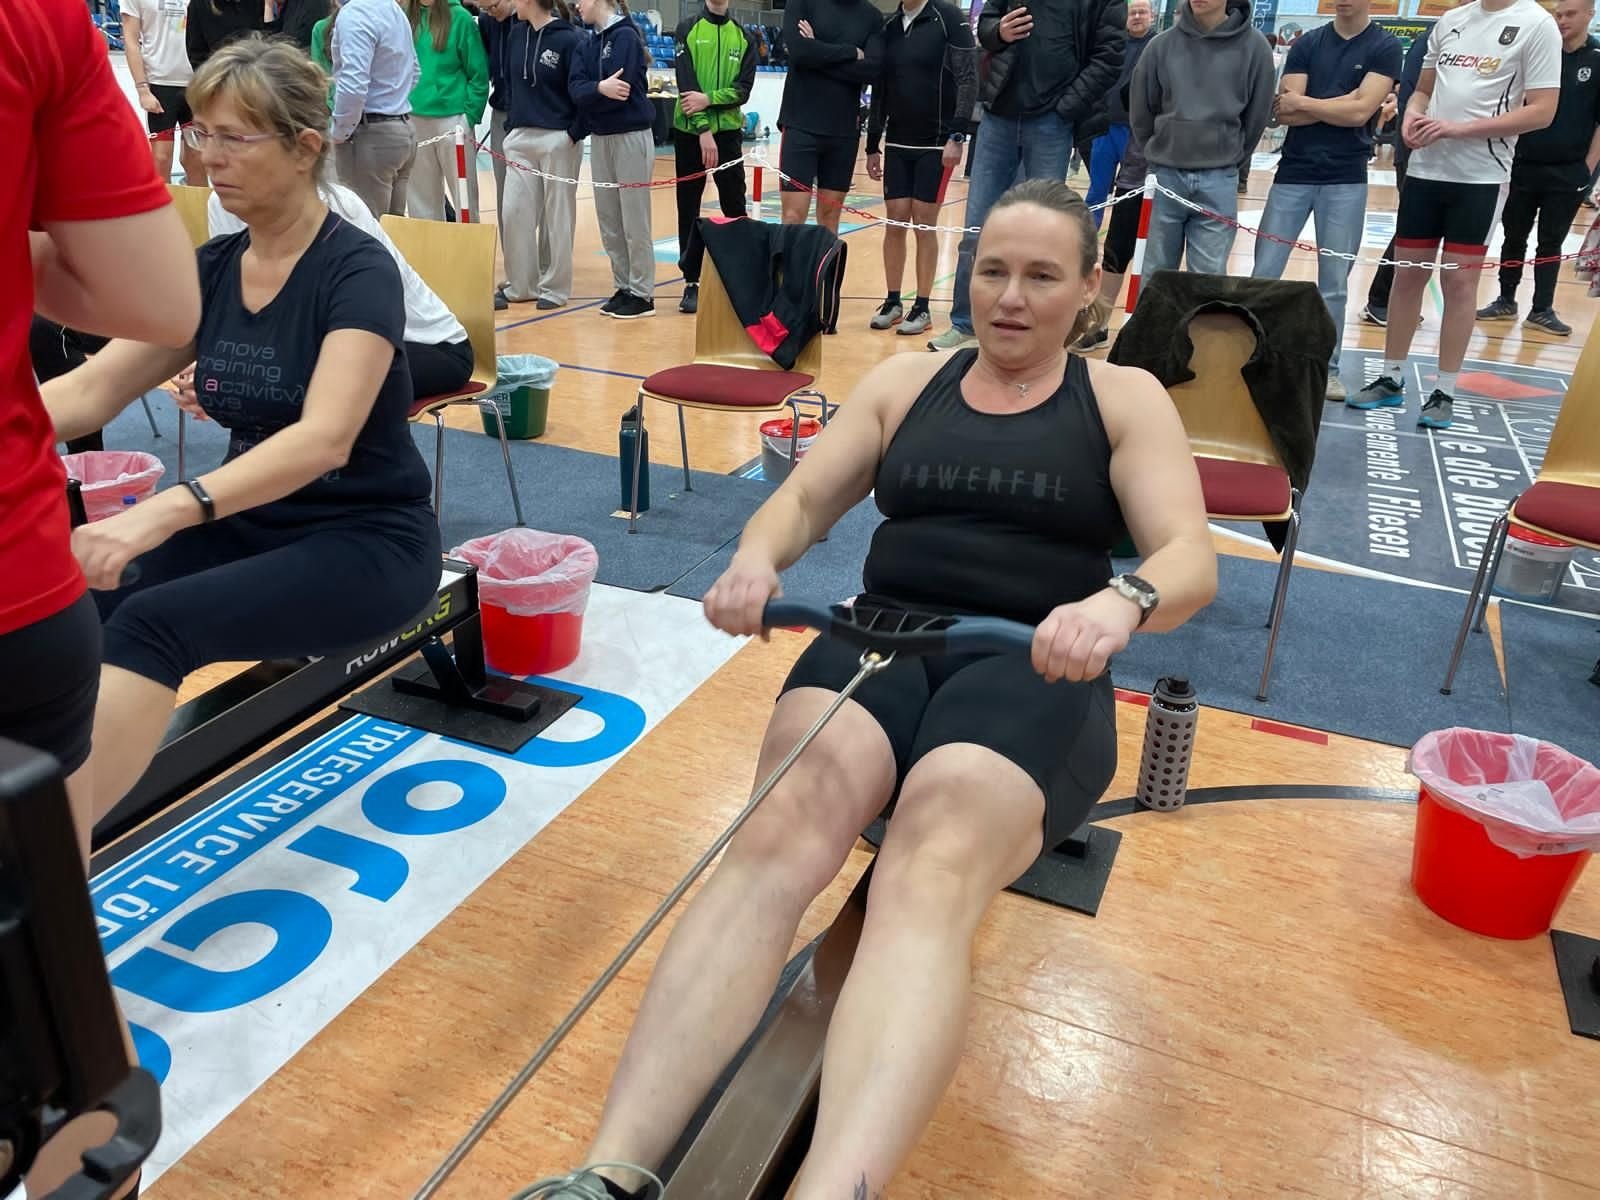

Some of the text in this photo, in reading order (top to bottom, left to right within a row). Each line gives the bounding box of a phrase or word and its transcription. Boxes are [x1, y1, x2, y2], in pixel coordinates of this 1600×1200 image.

[1438, 52, 1502, 72] CHECK24
[1364, 406, 1411, 481] Baueemente
[899, 463, 1066, 501] POWERFUL
[1444, 456, 1521, 489] die
[1367, 493, 1423, 558] Fliesen
[165, 719, 412, 876] TRIESERVICE
